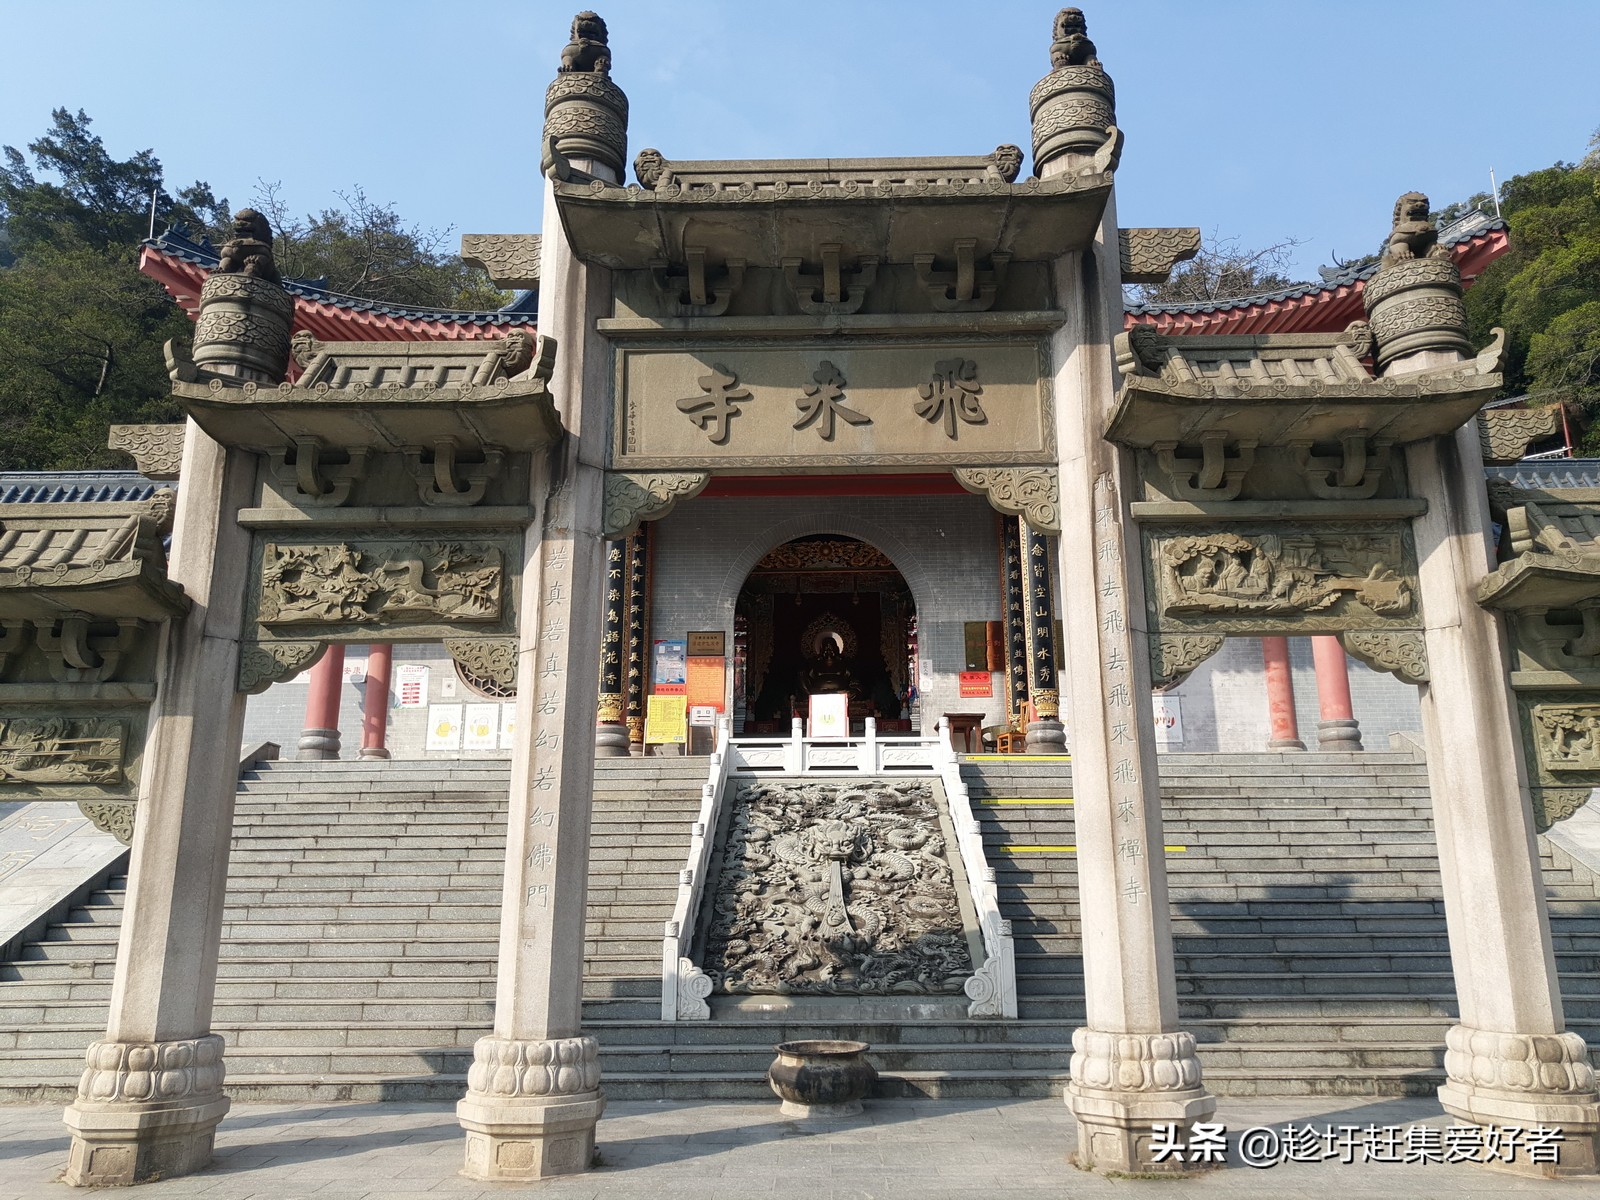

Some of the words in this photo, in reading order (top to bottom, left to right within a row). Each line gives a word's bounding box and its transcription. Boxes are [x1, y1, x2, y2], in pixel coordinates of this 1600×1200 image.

[1030, 530, 1051, 682] 念皆空山明水秀
[1094, 470, 1147, 907] 飛來飛去飛去飛來飛來禪寺
